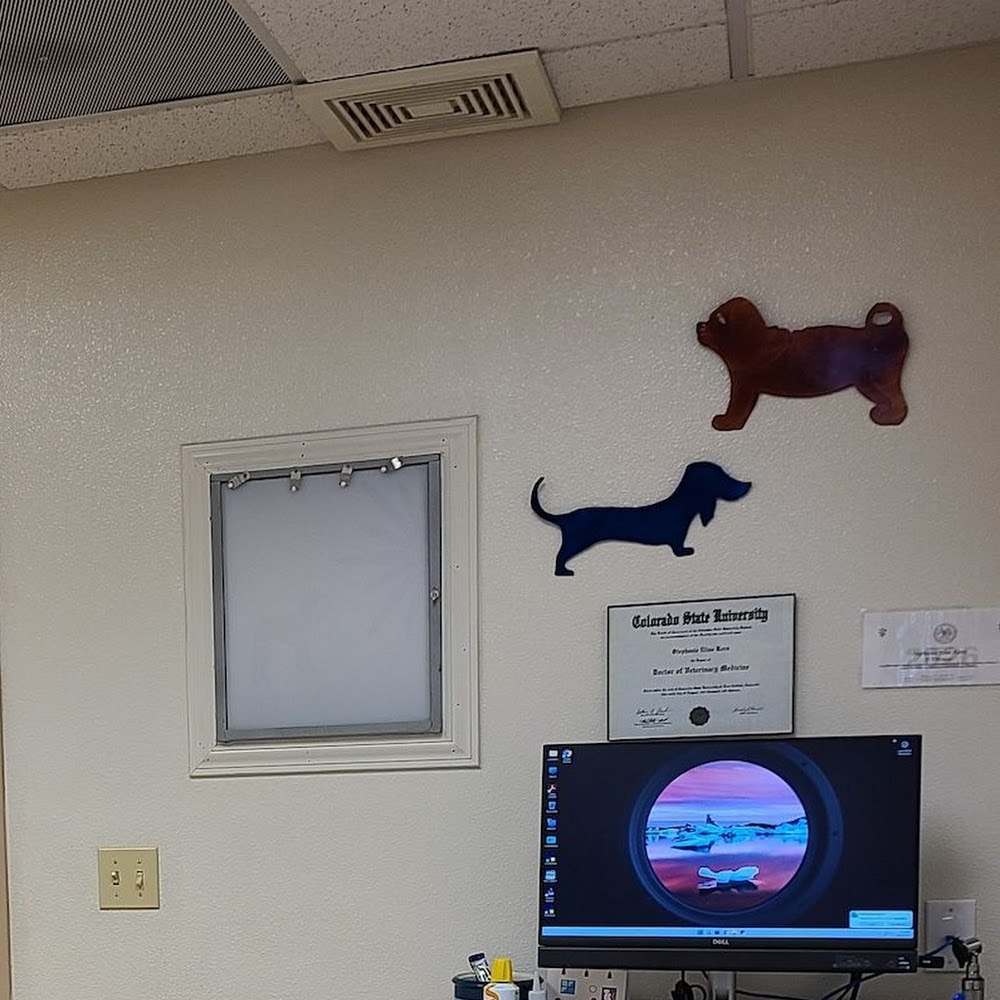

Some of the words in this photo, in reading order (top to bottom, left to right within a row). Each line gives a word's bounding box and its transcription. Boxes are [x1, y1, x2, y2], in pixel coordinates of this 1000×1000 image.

[632, 613, 679, 629] Colorado
[683, 611, 710, 625] State
[713, 607, 768, 623] University
[685, 666, 718, 674] Veterinary
[720, 664, 750, 672] Medicine
